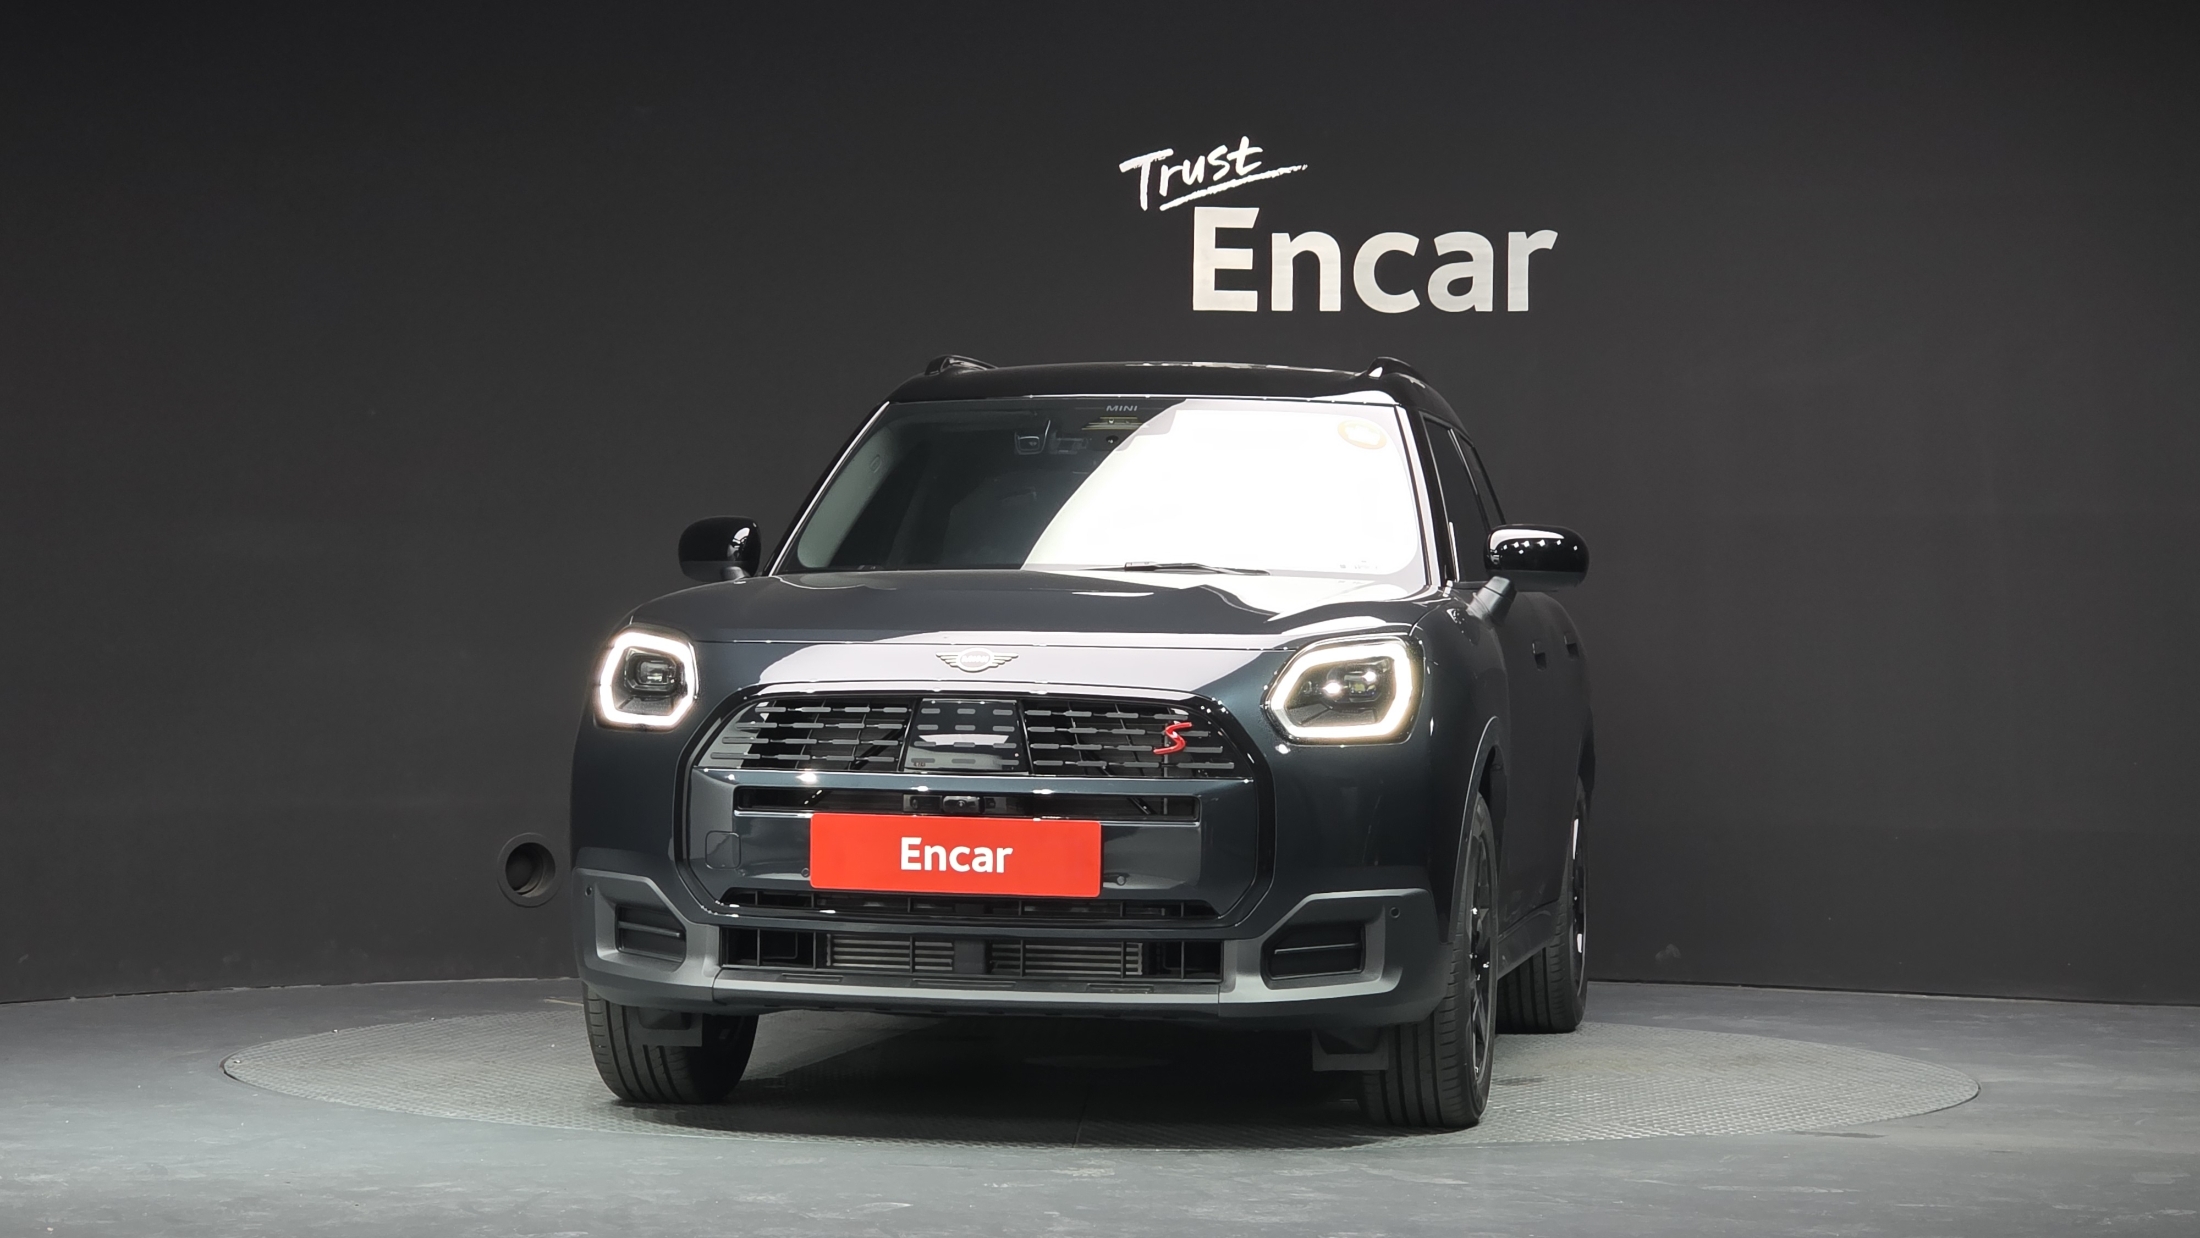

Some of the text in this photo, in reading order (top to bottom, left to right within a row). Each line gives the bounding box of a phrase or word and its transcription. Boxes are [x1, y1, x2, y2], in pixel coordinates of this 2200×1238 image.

[1119, 136, 1264, 211] Trust
[1192, 206, 1558, 313] Encar
[1153, 722, 1193, 755] S
[900, 836, 1014, 874] Encar
